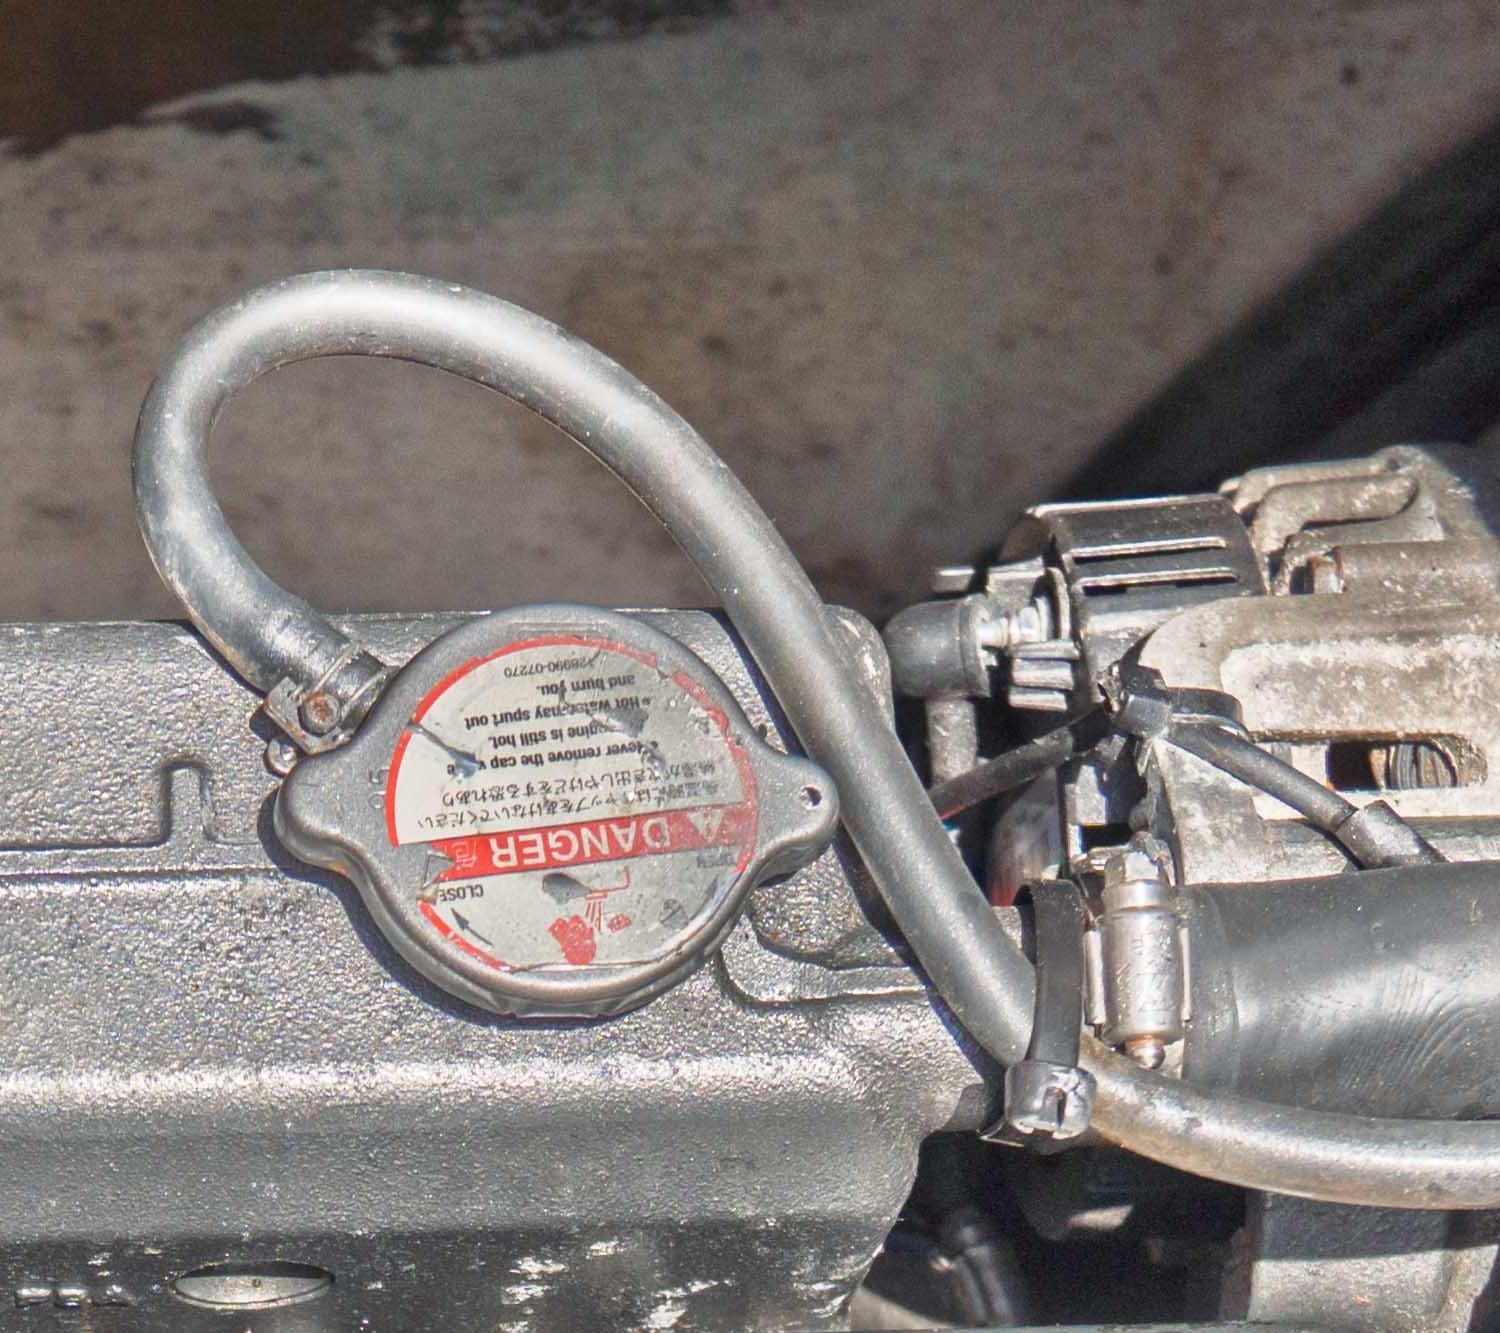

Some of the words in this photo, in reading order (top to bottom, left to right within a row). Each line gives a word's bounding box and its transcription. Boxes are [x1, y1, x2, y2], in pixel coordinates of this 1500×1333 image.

[572, 677, 602, 693] burn
[607, 674, 635, 689] and
[465, 714, 489, 730] out
[493, 707, 531, 728] spurt
[488, 733, 516, 750] hot.
[521, 728, 547, 745] still
[550, 729, 560, 743] is
[521, 754, 544, 768] the
[548, 746, 602, 764] remove
[490, 756, 517, 772] cap
[490, 817, 671, 868] DANGER
[440, 884, 484, 902] CLOSE
